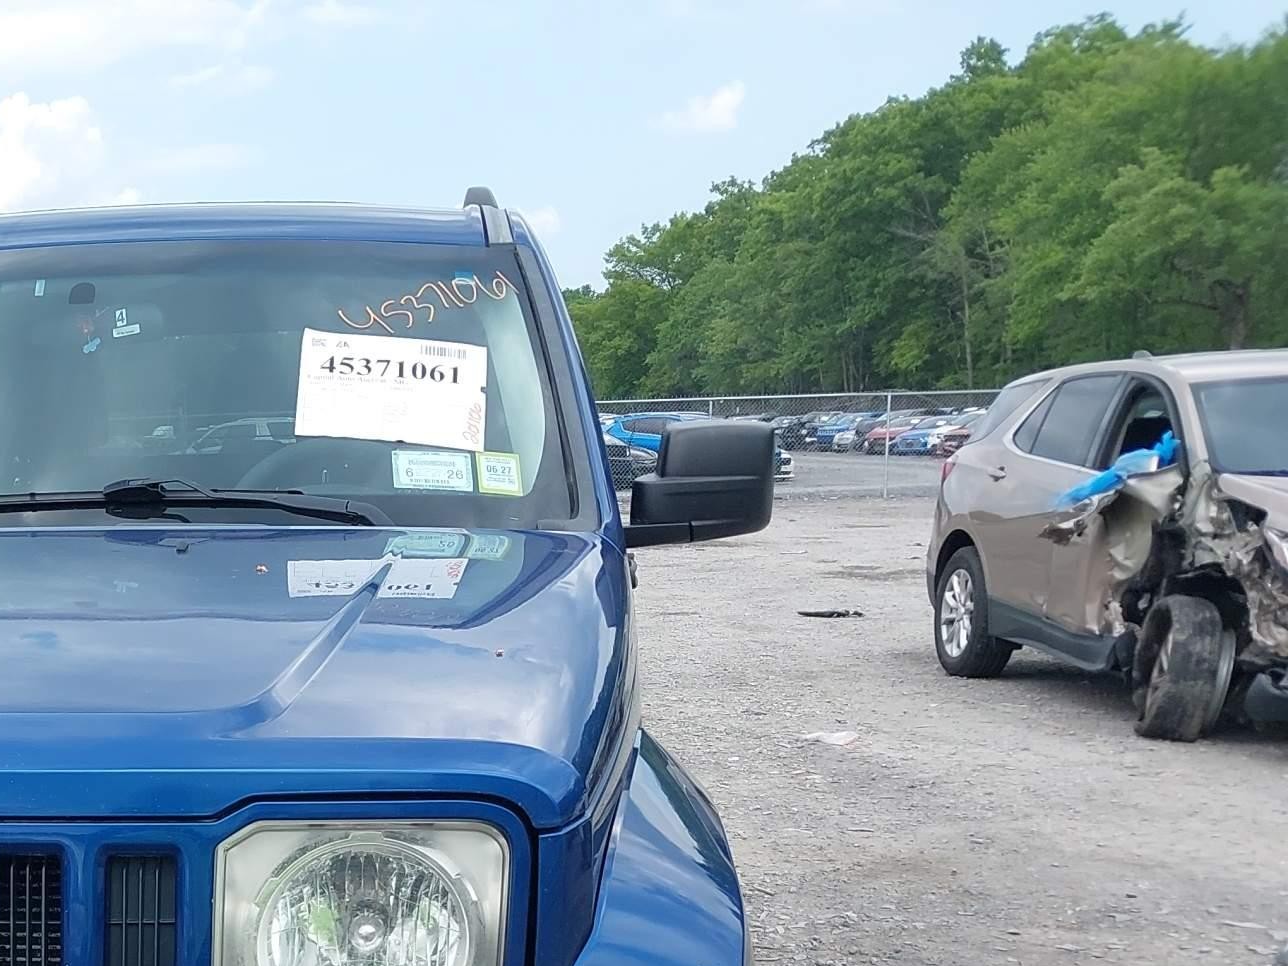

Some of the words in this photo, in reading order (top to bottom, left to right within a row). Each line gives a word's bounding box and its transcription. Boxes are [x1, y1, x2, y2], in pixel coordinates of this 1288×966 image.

[319, 355, 460, 385] 45371061
[447, 469, 464, 480] 26
[500, 466, 512, 475] 27
